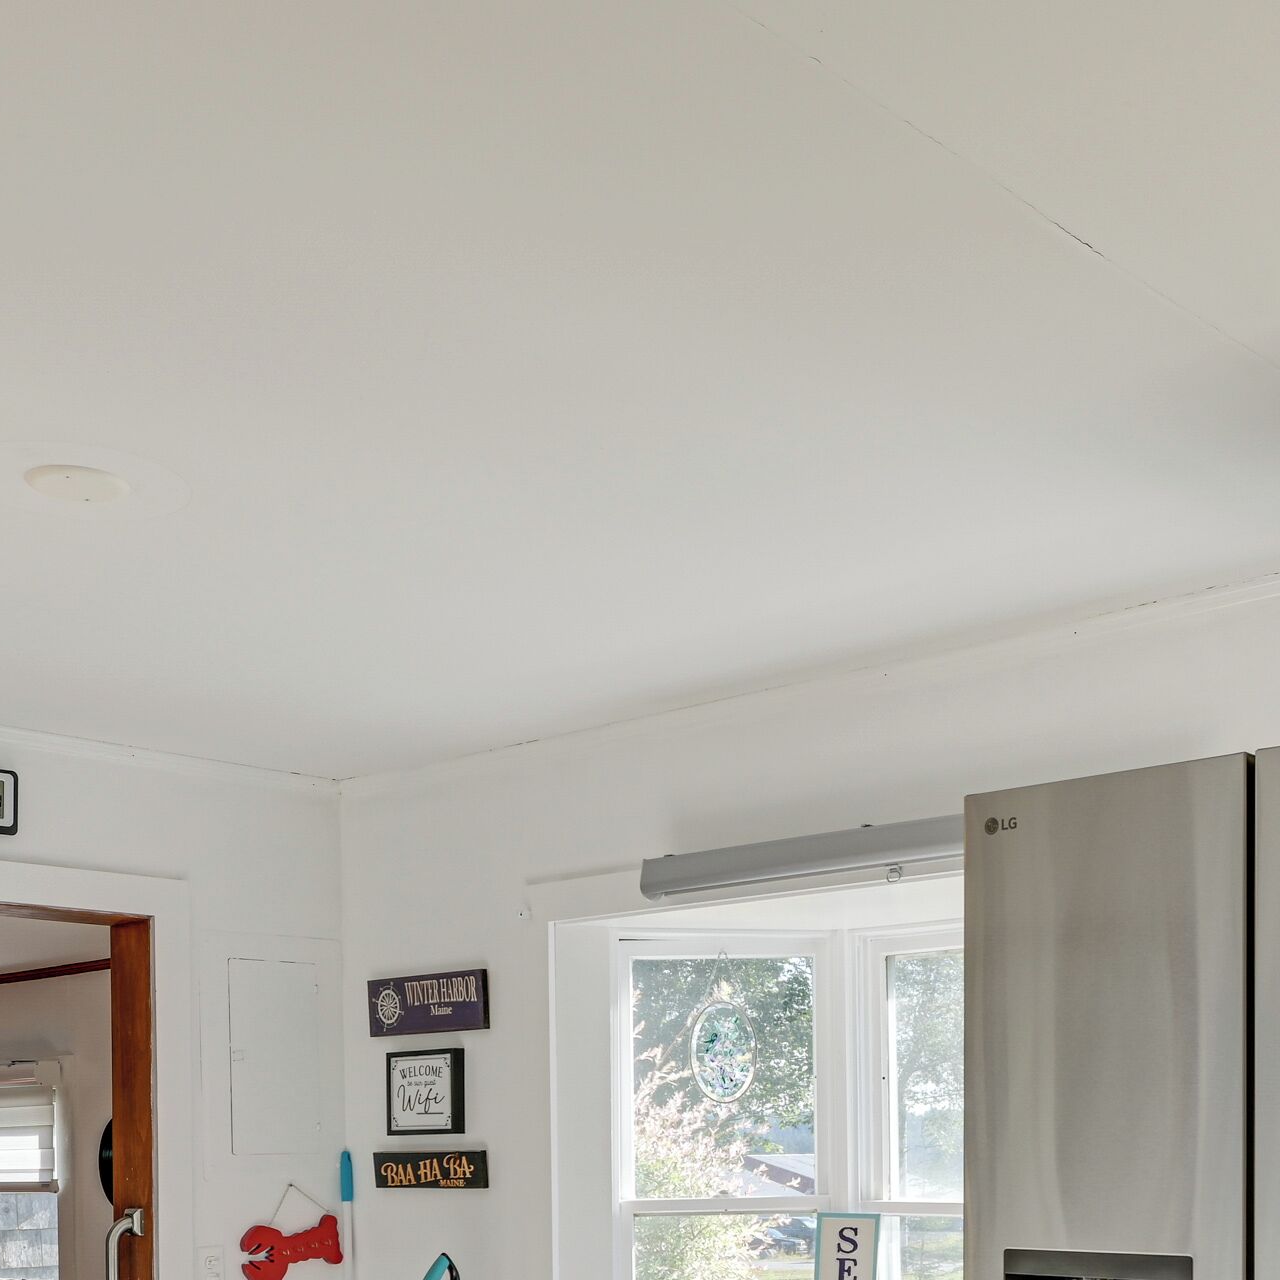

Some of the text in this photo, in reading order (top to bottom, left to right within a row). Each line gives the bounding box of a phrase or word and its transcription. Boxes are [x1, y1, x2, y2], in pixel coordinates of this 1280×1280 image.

[1001, 816, 1018, 831] LG
[404, 975, 478, 1007] WINTER HARBOR
[430, 1003, 453, 1016] Maine
[399, 1064, 444, 1080] WELCOME
[397, 1084, 446, 1114] Wifi
[380, 1153, 475, 1187] BAA HA BA
